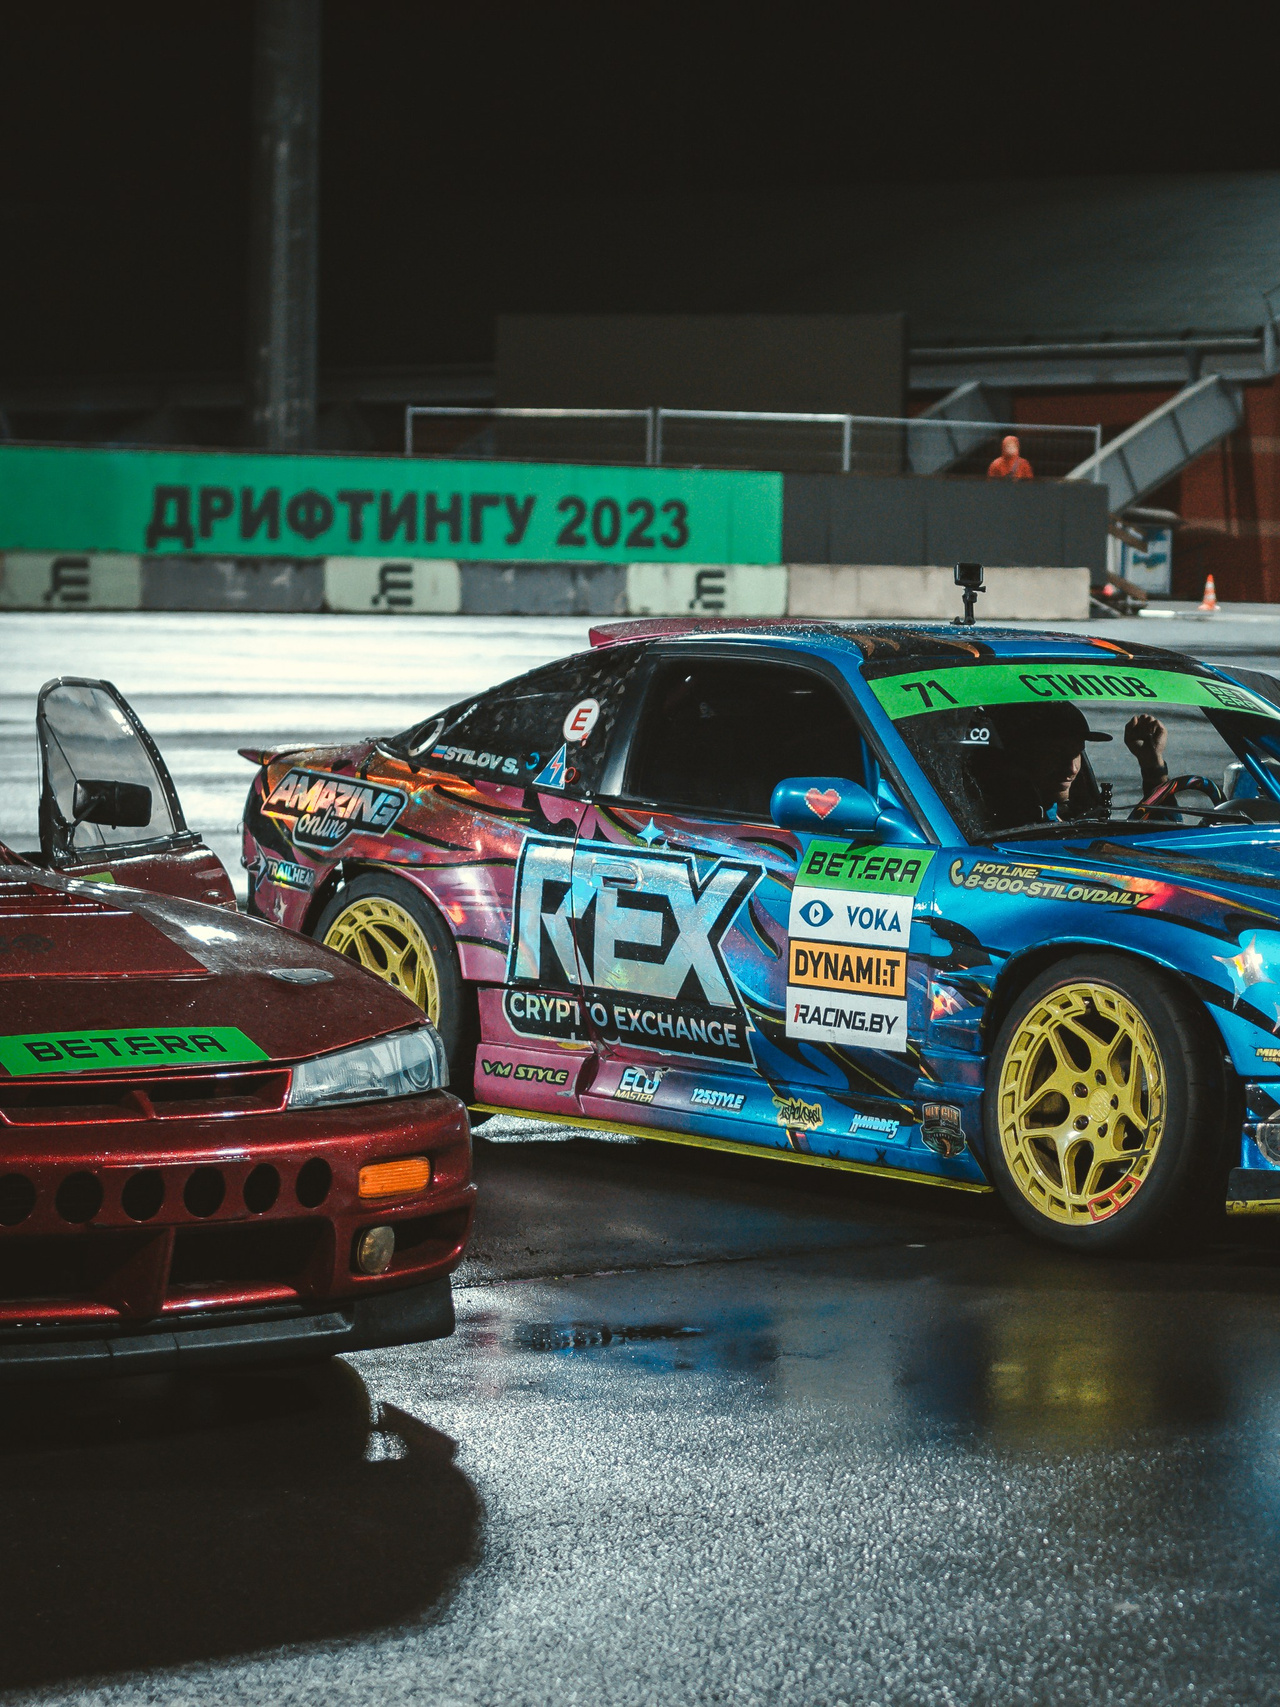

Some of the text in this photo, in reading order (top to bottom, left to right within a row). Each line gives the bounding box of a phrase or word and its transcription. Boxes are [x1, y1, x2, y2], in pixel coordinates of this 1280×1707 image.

[145, 482, 690, 550] ДРИФТИНГУ 2023
[900, 680, 960, 708] 71
[570, 708, 593, 731] E
[443, 745, 520, 776] STILOV S.
[268, 774, 401, 825] AMAZING
[296, 811, 347, 840] online
[973, 862, 1039, 879] HOTLINE:
[965, 874, 1149, 906] 8-800-STILOVDAILY
[516, 838, 758, 1008] REX
[847, 905, 902, 932] VOKA
[511, 992, 741, 1050] CRYPTO EXCHANGE
[794, 1004, 899, 1035] 1RACING.BY
[483, 1061, 568, 1084] VM STYLE
[615, 1089, 654, 1104] MASTER
[691, 1088, 745, 1110] 125STYLE
